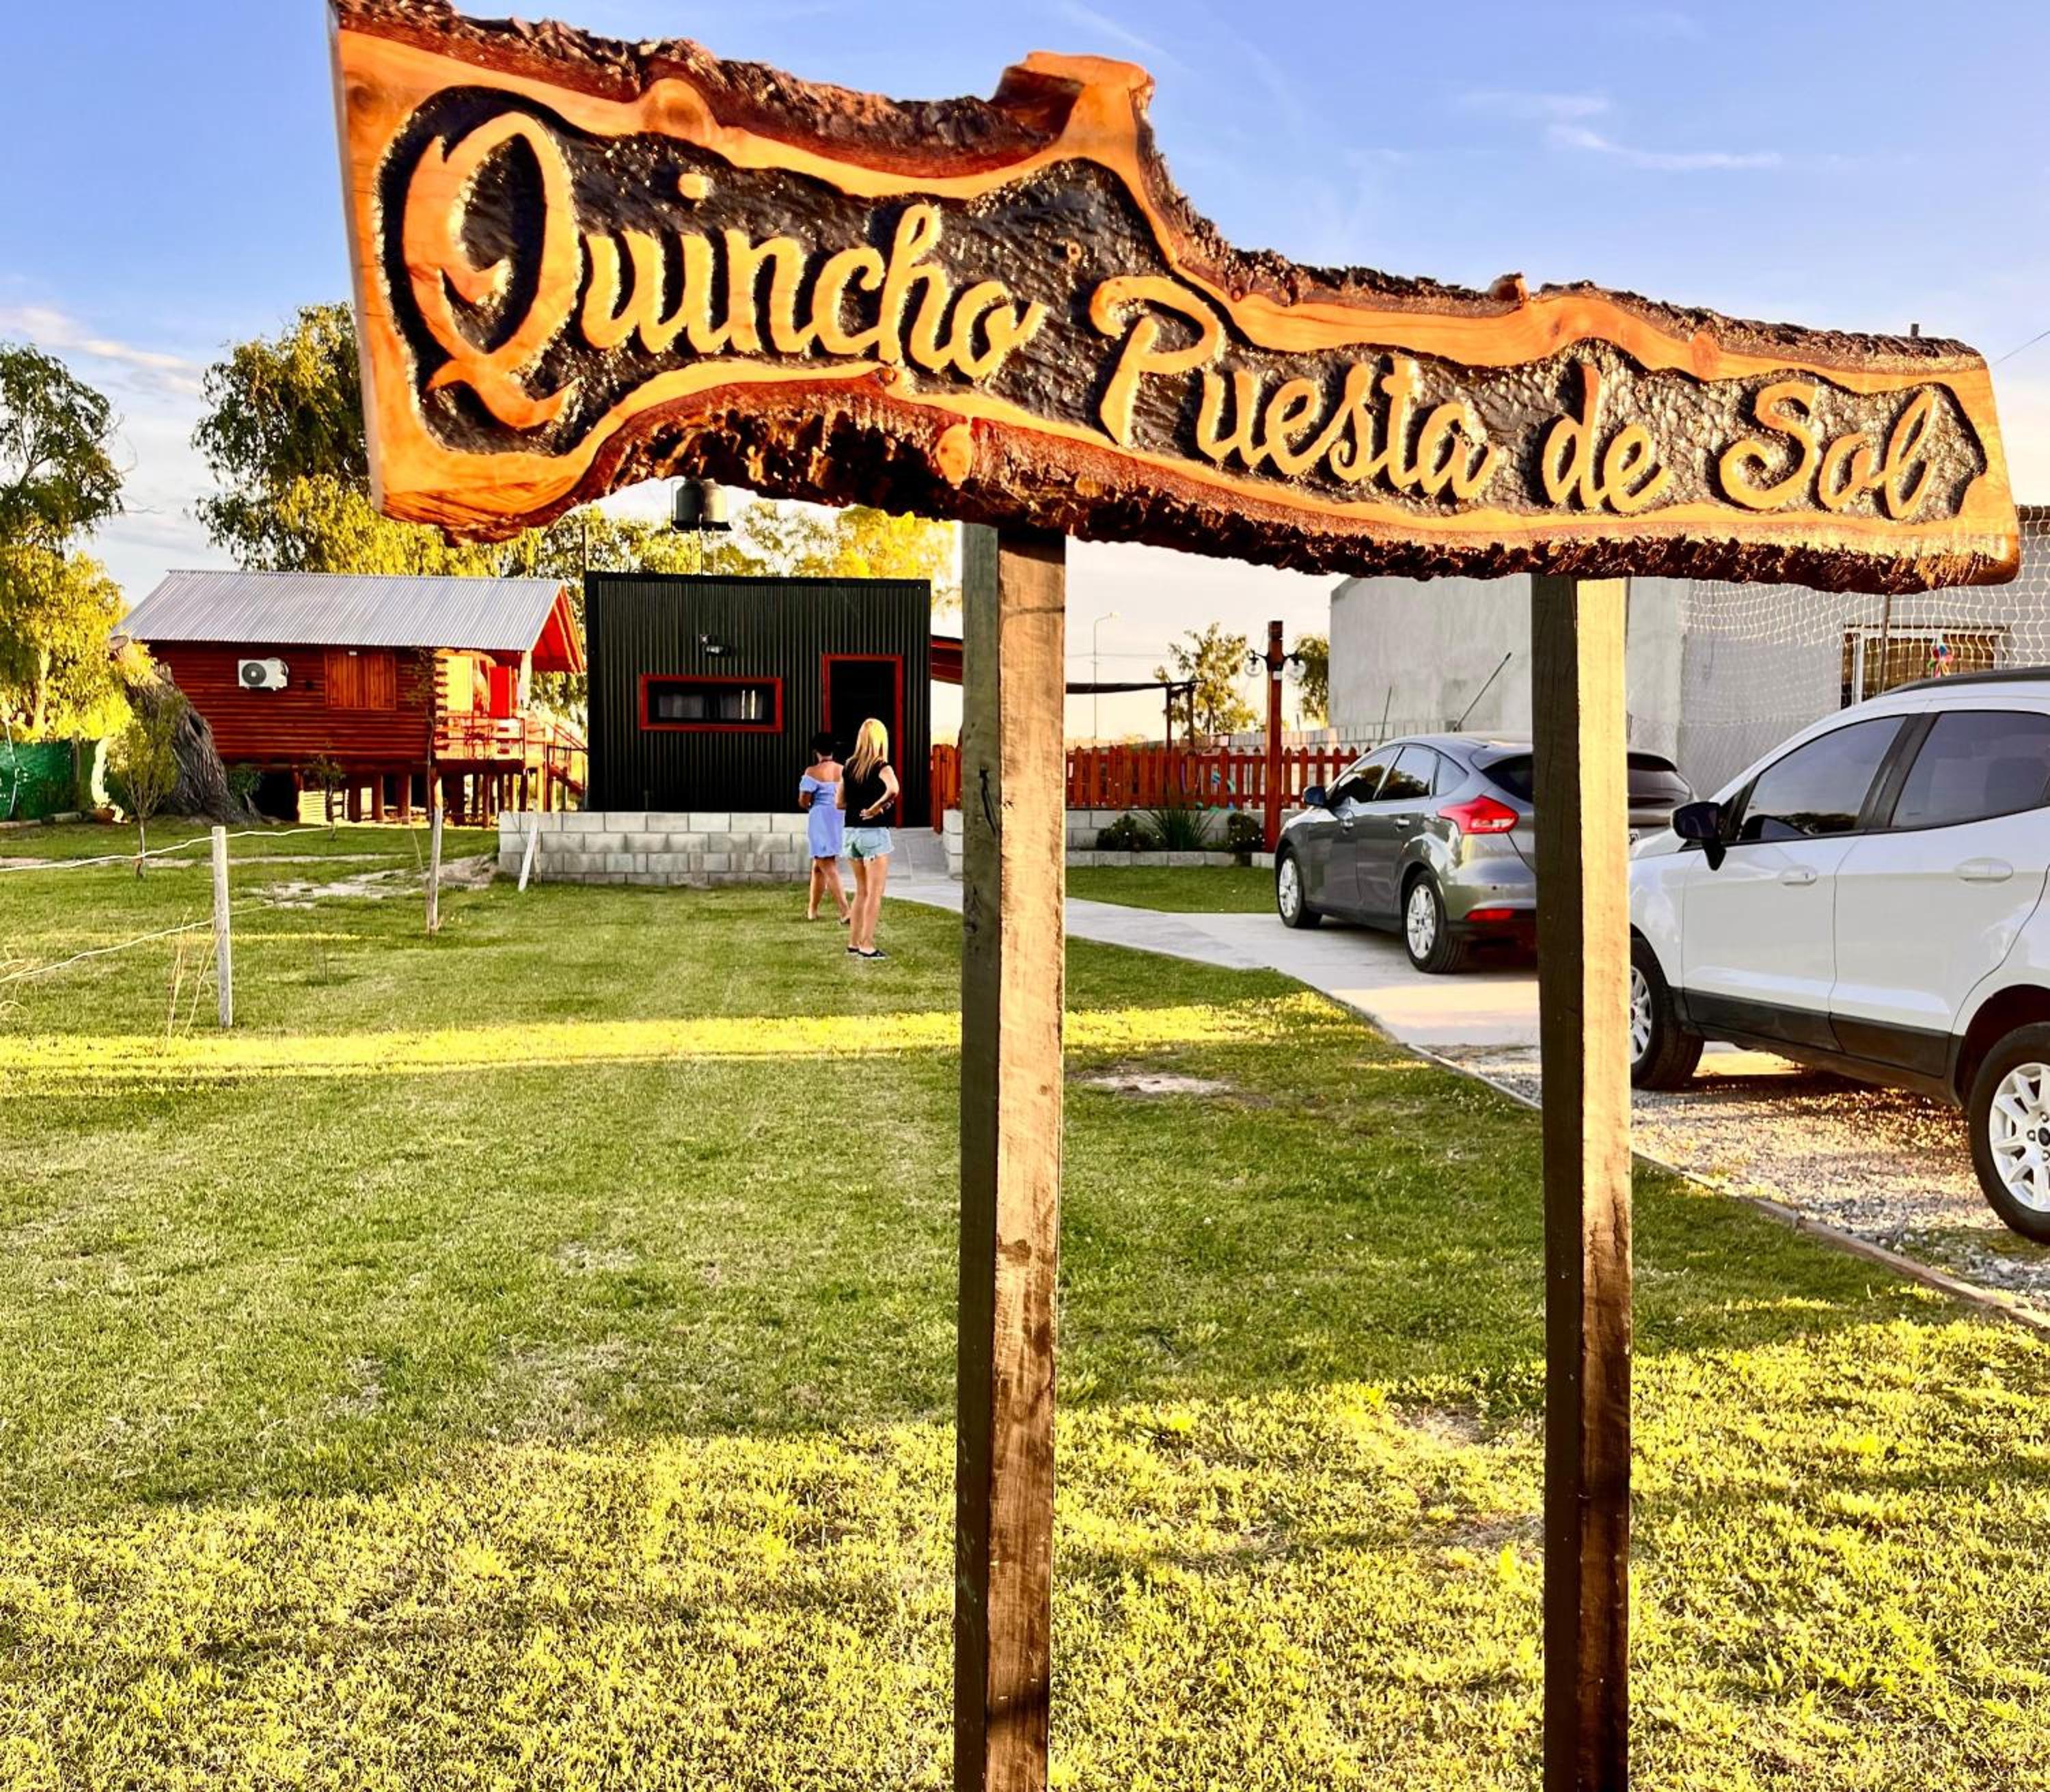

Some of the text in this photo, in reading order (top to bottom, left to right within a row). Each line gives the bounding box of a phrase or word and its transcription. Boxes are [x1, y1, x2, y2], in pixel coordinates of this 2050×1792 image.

[402, 111, 1935, 519] Quincho Puesta de Sol
